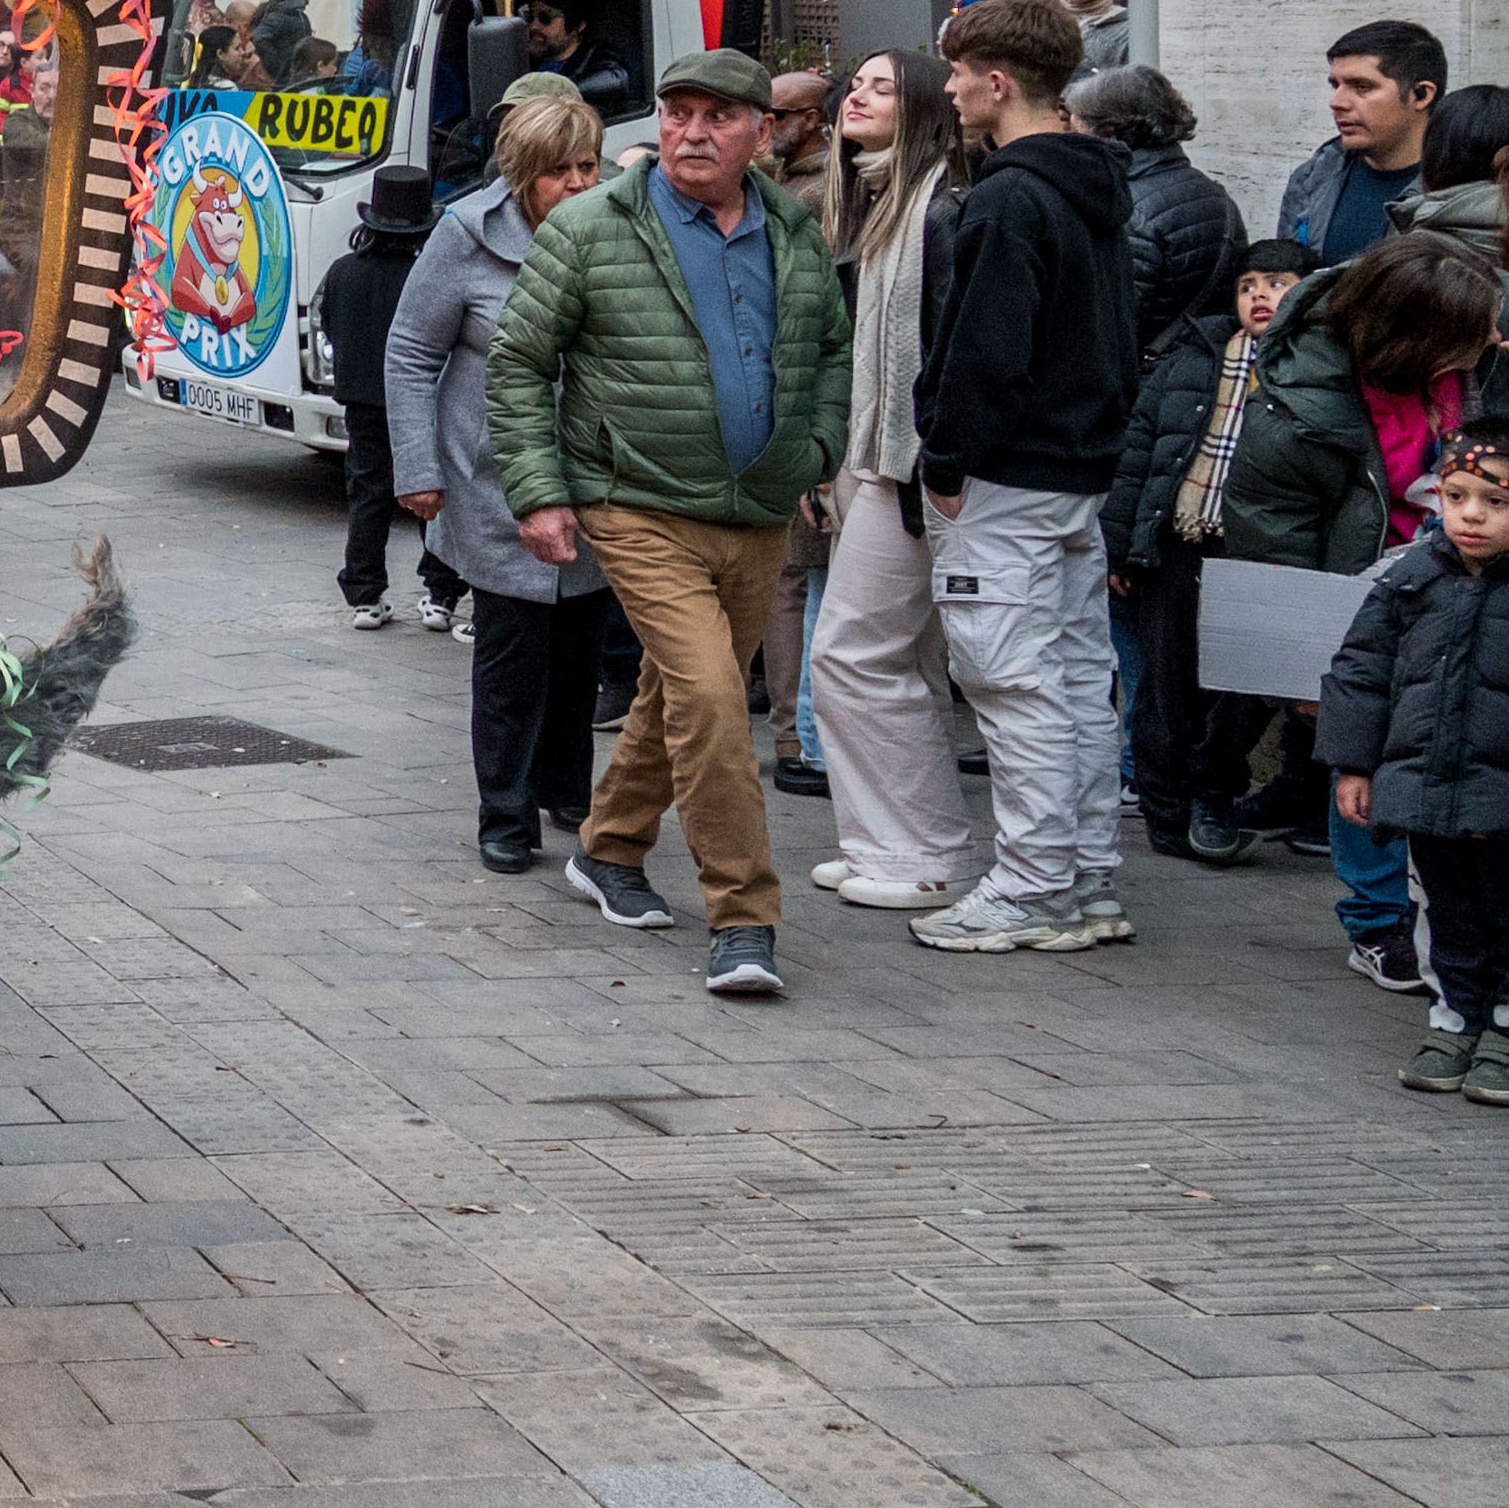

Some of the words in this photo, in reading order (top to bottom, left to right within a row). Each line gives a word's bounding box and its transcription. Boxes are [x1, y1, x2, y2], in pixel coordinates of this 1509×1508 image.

[258, 94, 377, 156] RUBEO
[162, 121, 271, 198] GRAND
[181, 313, 257, 368] PRIX
[188, 383, 223, 413] 0005
[226, 394, 255, 419] MHF
